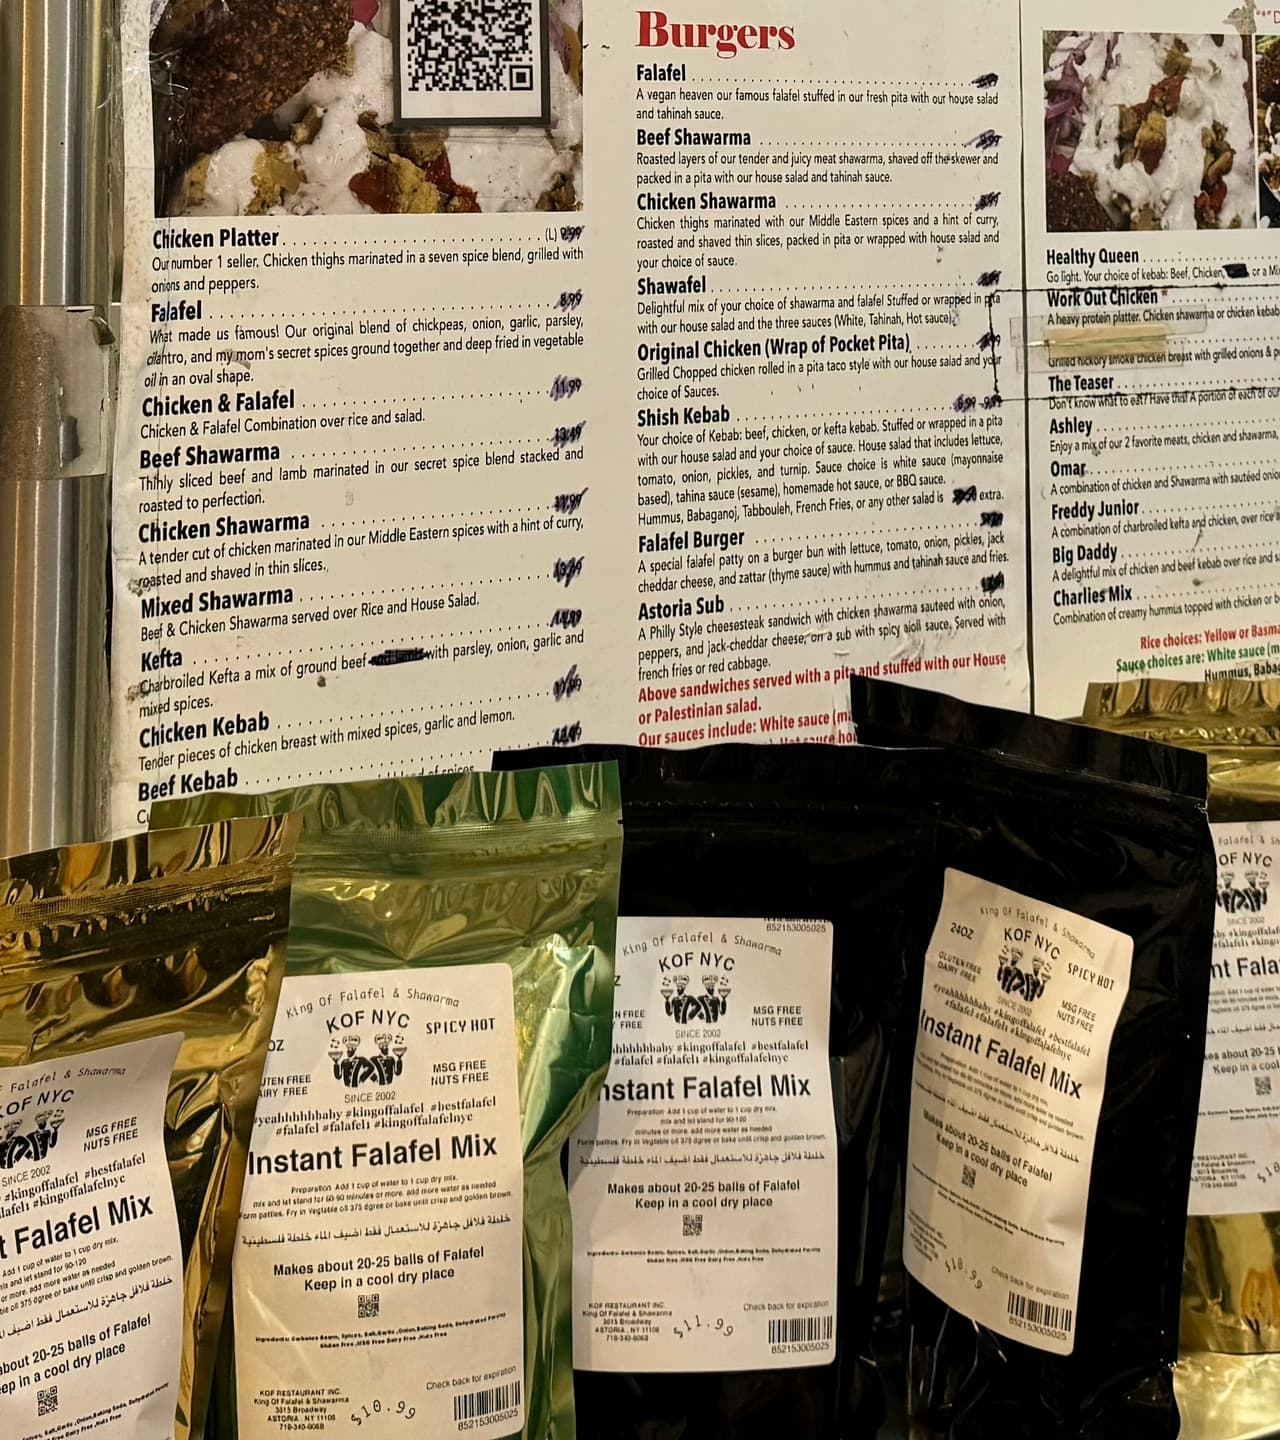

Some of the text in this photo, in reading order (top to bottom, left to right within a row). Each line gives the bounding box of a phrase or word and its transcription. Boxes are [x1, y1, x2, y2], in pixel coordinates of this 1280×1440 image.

[636, 11, 796, 60] Burgers
[153, 227, 280, 251] Chicken Platter
[1046, 249, 1139, 268] Healthy Queen
[151, 275, 259, 293] onions and peppers.
[304, 1266, 455, 1293] Keep in a cool dry place
